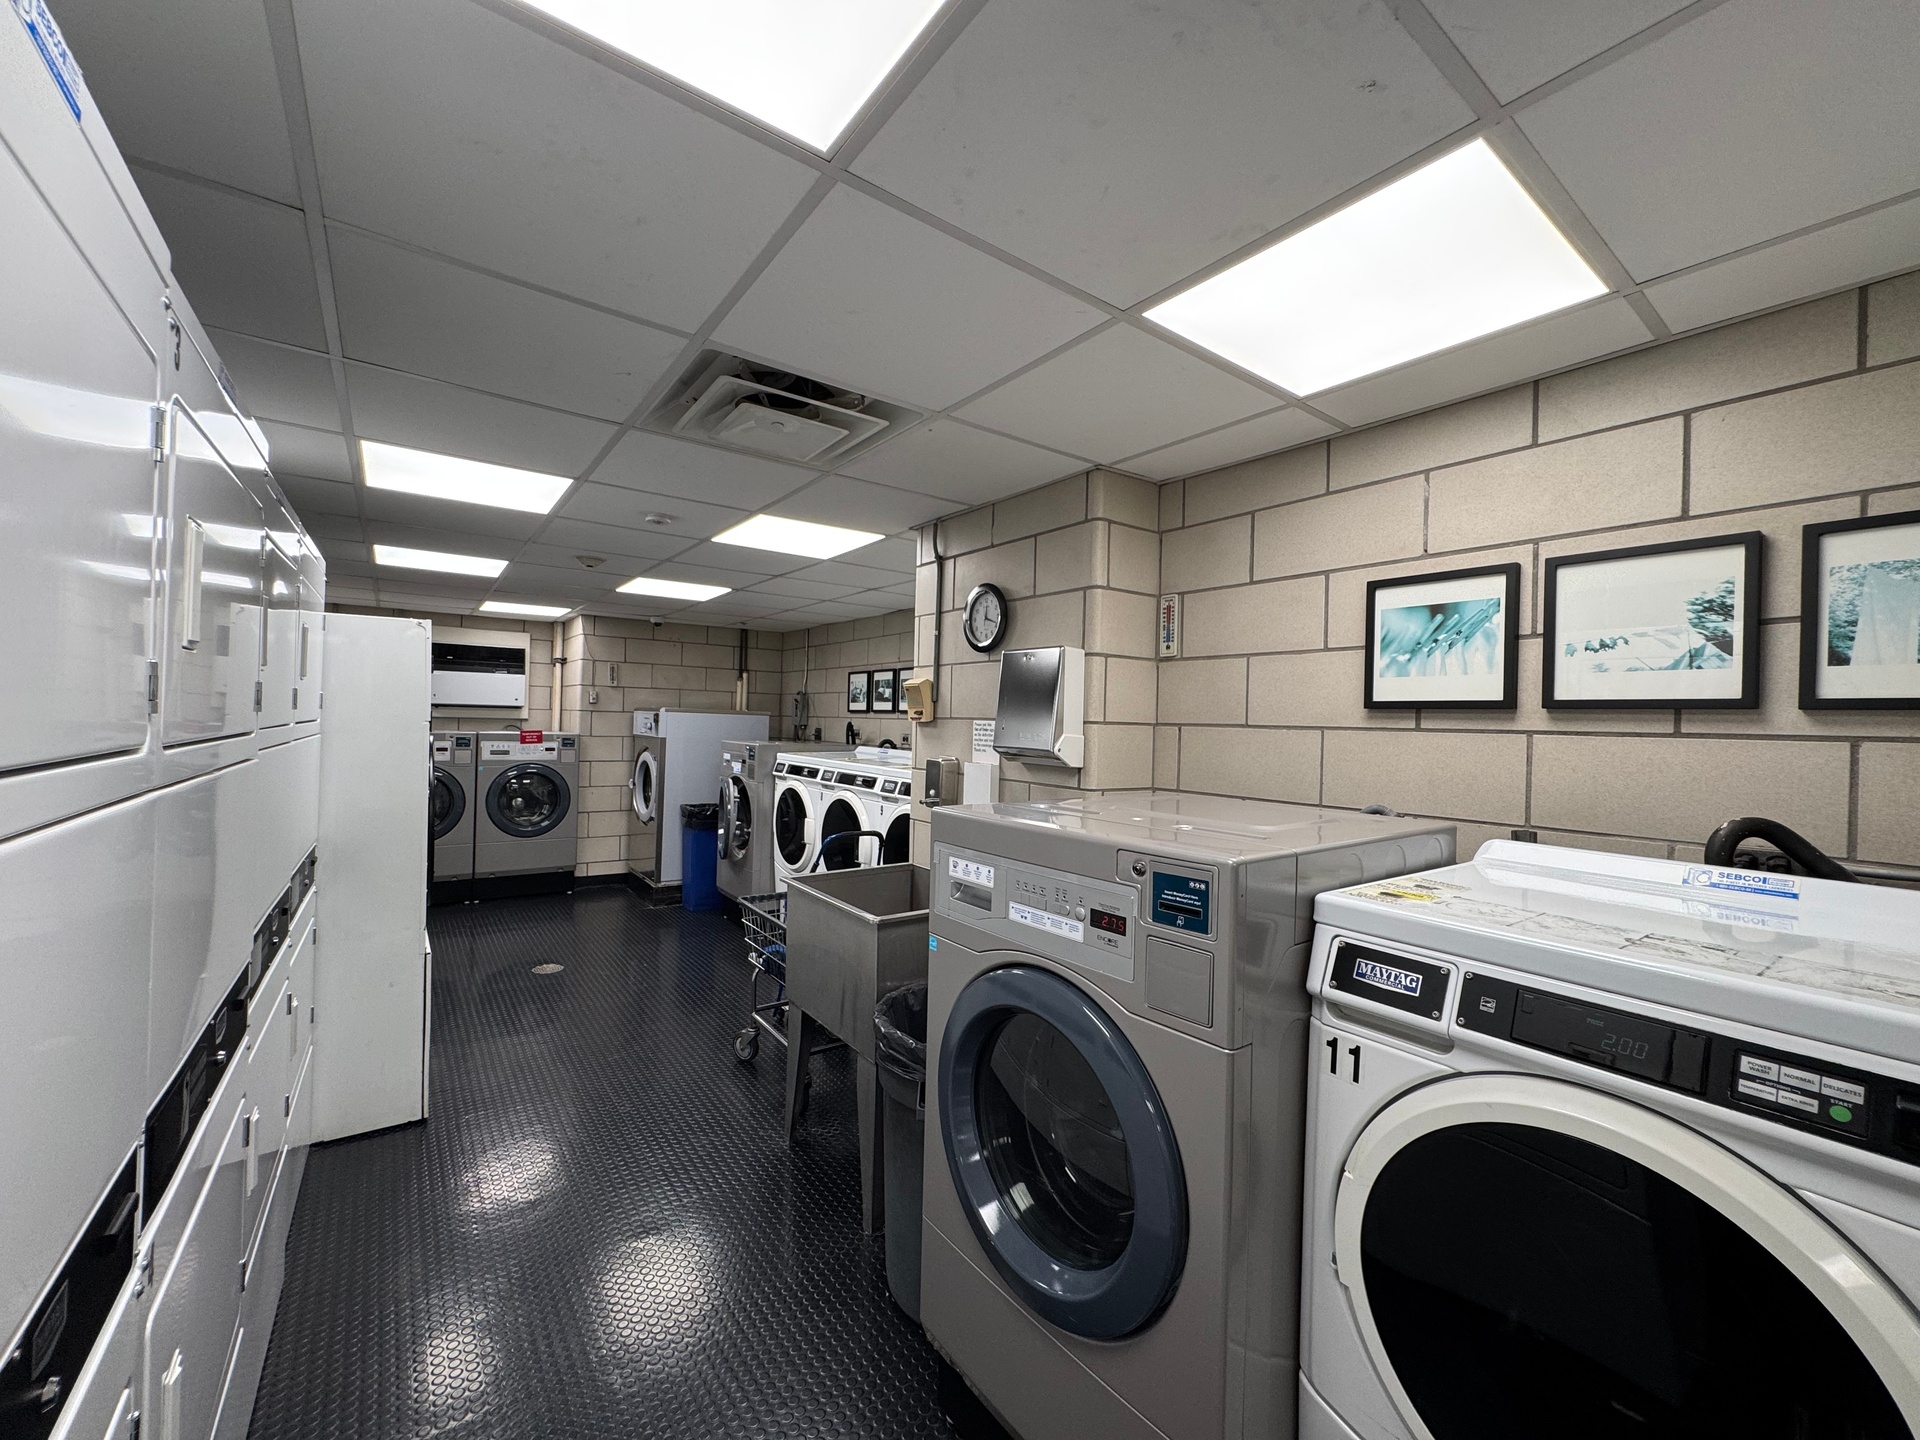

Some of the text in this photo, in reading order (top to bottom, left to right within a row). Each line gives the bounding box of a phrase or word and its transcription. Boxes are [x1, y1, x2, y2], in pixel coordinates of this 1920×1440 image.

[174, 324, 181, 372] 3
[1717, 872, 1762, 884] SEBCO
[1358, 961, 1418, 988] MAYTAG
[1365, 974, 1406, 991] COMMERCIAL
[1601, 1033, 1649, 1060] 2.00
[1326, 1037, 1361, 1084] 11
[1747, 1060, 1773, 1072] POWER
[1748, 1066, 1771, 1076] WASH
[1784, 1072, 1816, 1086] NORMAL
[1740, 1084, 1775, 1097] TEMPERATURE
[1765, 1080, 1791, 1092] OPTIONS
[1823, 1083, 1862, 1098] DELICATES
[1781, 1095, 1815, 1108] EXTRA RINSE
[1830, 1099, 1854, 1109] START
